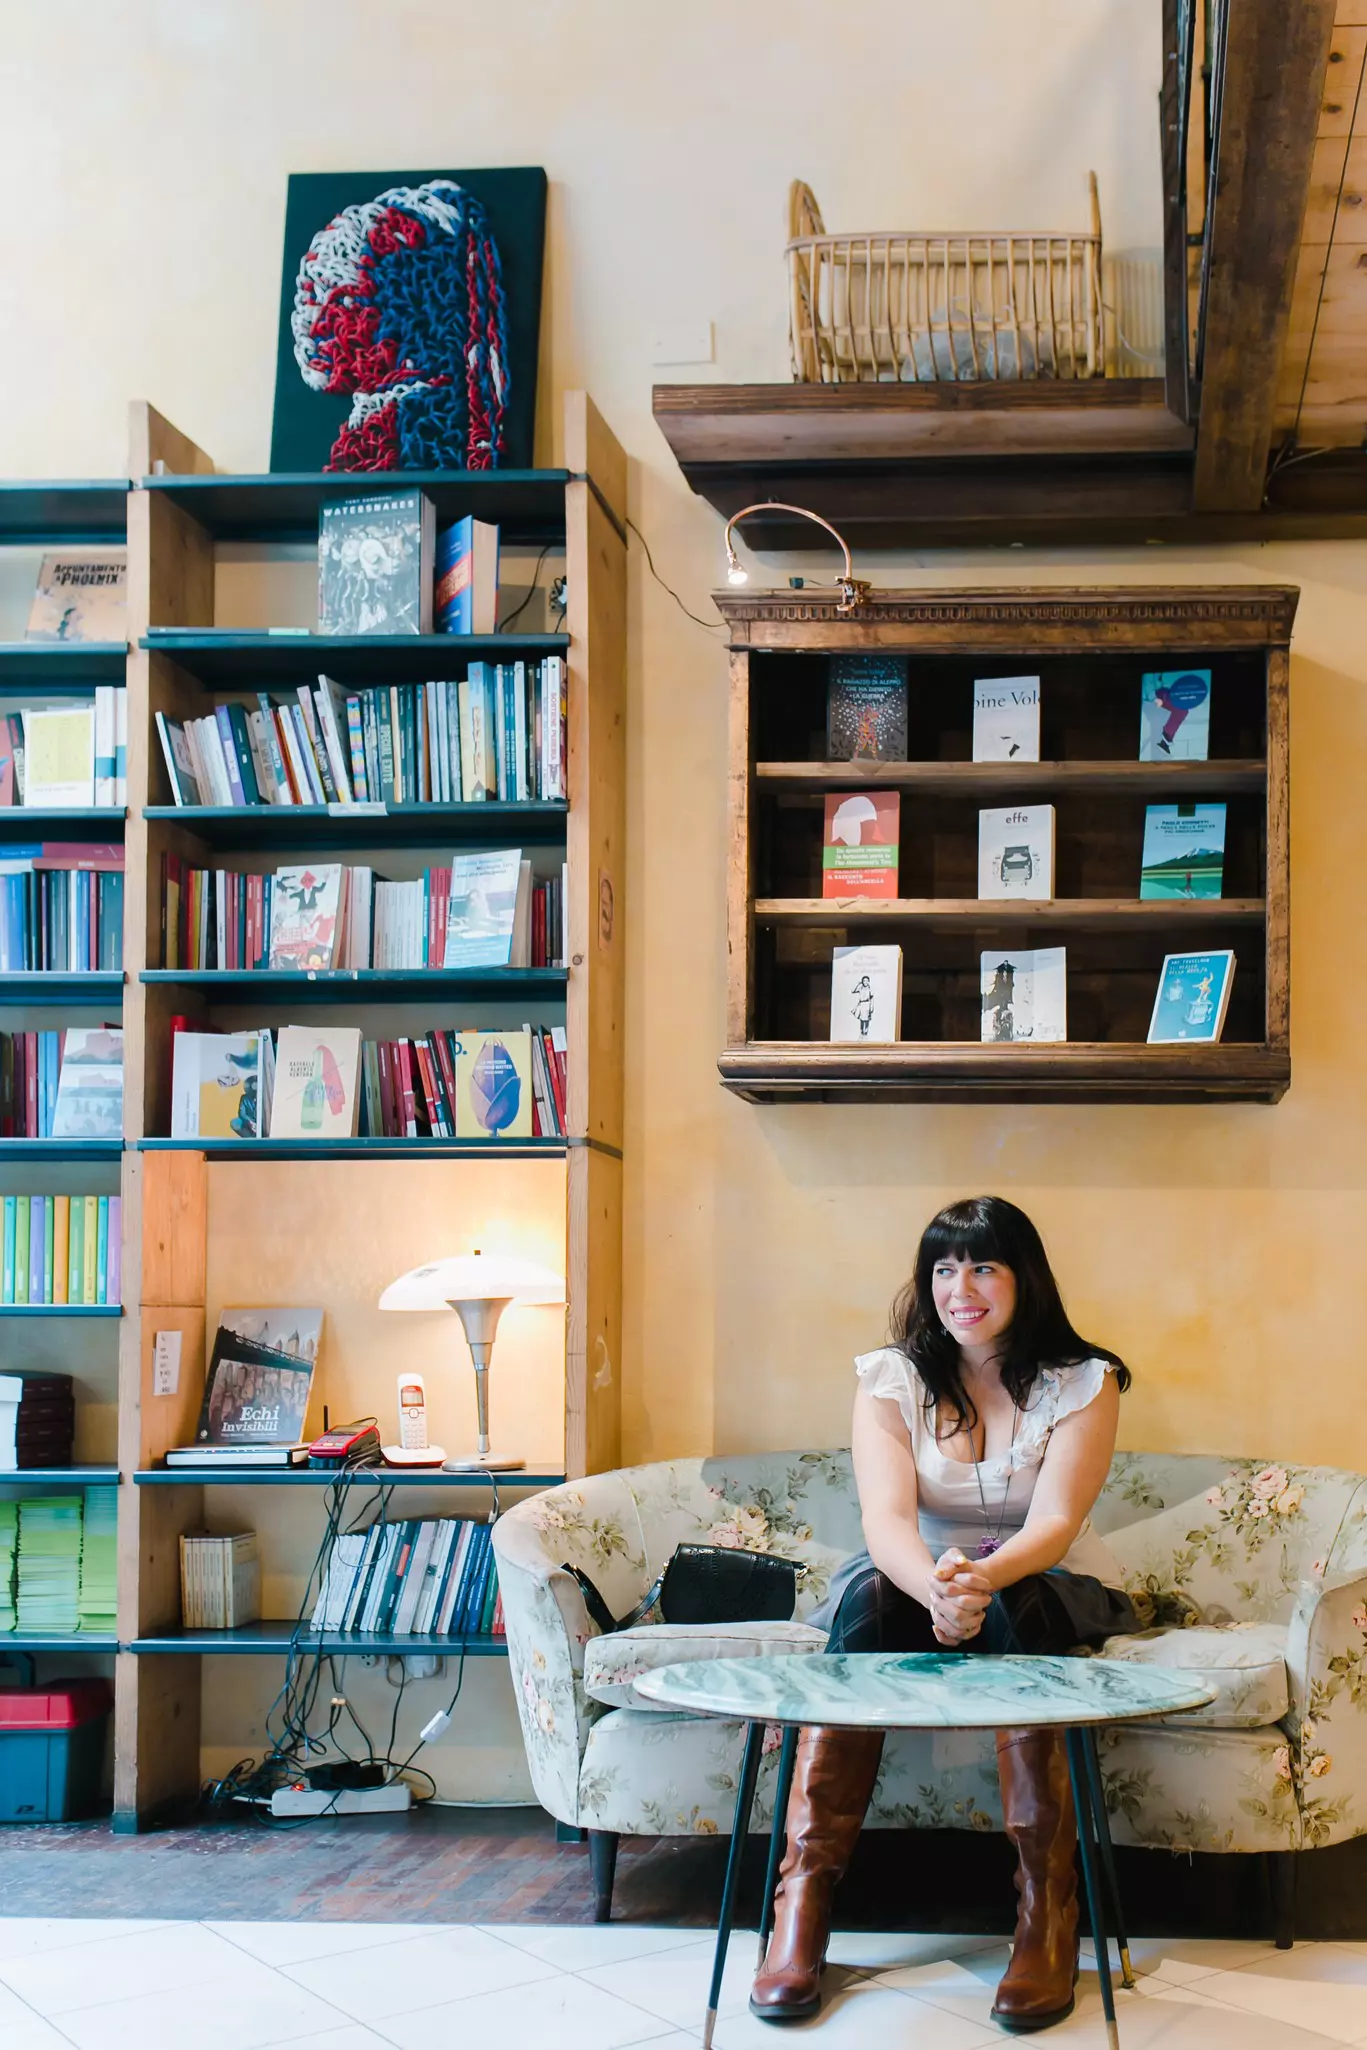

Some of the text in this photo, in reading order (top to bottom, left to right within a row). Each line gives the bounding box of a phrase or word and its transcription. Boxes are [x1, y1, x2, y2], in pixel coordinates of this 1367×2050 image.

[323, 499, 414, 517] WATERSNAKES
[53, 564, 126, 574] APPUNTAMENTO
[61, 572, 118, 586] PHOENIX
[1005, 812, 1029, 824] effe
[239, 1405, 280, 1421] Echi
[221, 1421, 278, 1432] Invisibili
